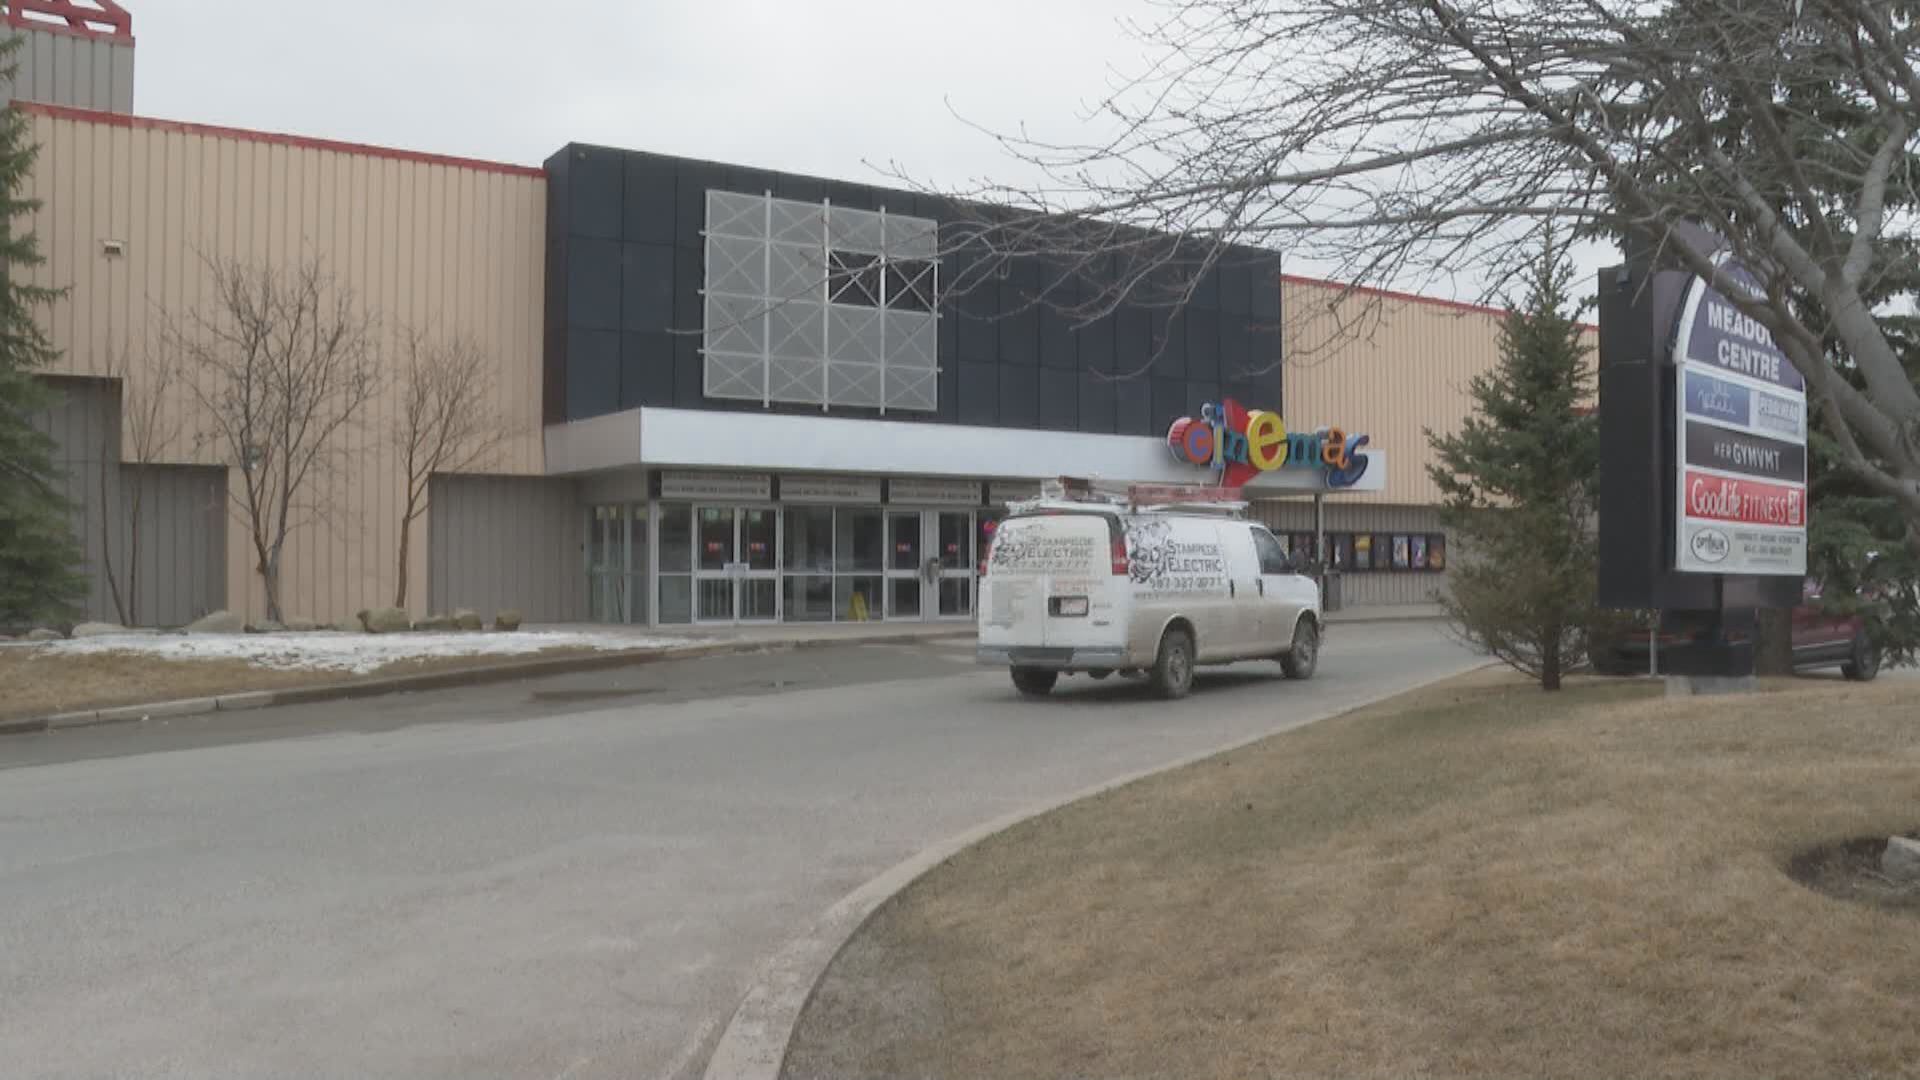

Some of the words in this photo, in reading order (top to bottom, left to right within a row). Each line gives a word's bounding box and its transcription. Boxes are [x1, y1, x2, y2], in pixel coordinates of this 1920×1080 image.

[1708, 301, 1777, 350] MEADO
[1718, 340, 1780, 380] CENTRE
[1168, 402, 1370, 488] cinemas
[1691, 478, 1740, 518] GoodLife
[1743, 493, 1786, 523] FITNESS
[1027, 546, 1096, 558] ELECTRIC
[1167, 557, 1224, 572] ELECTRIC
